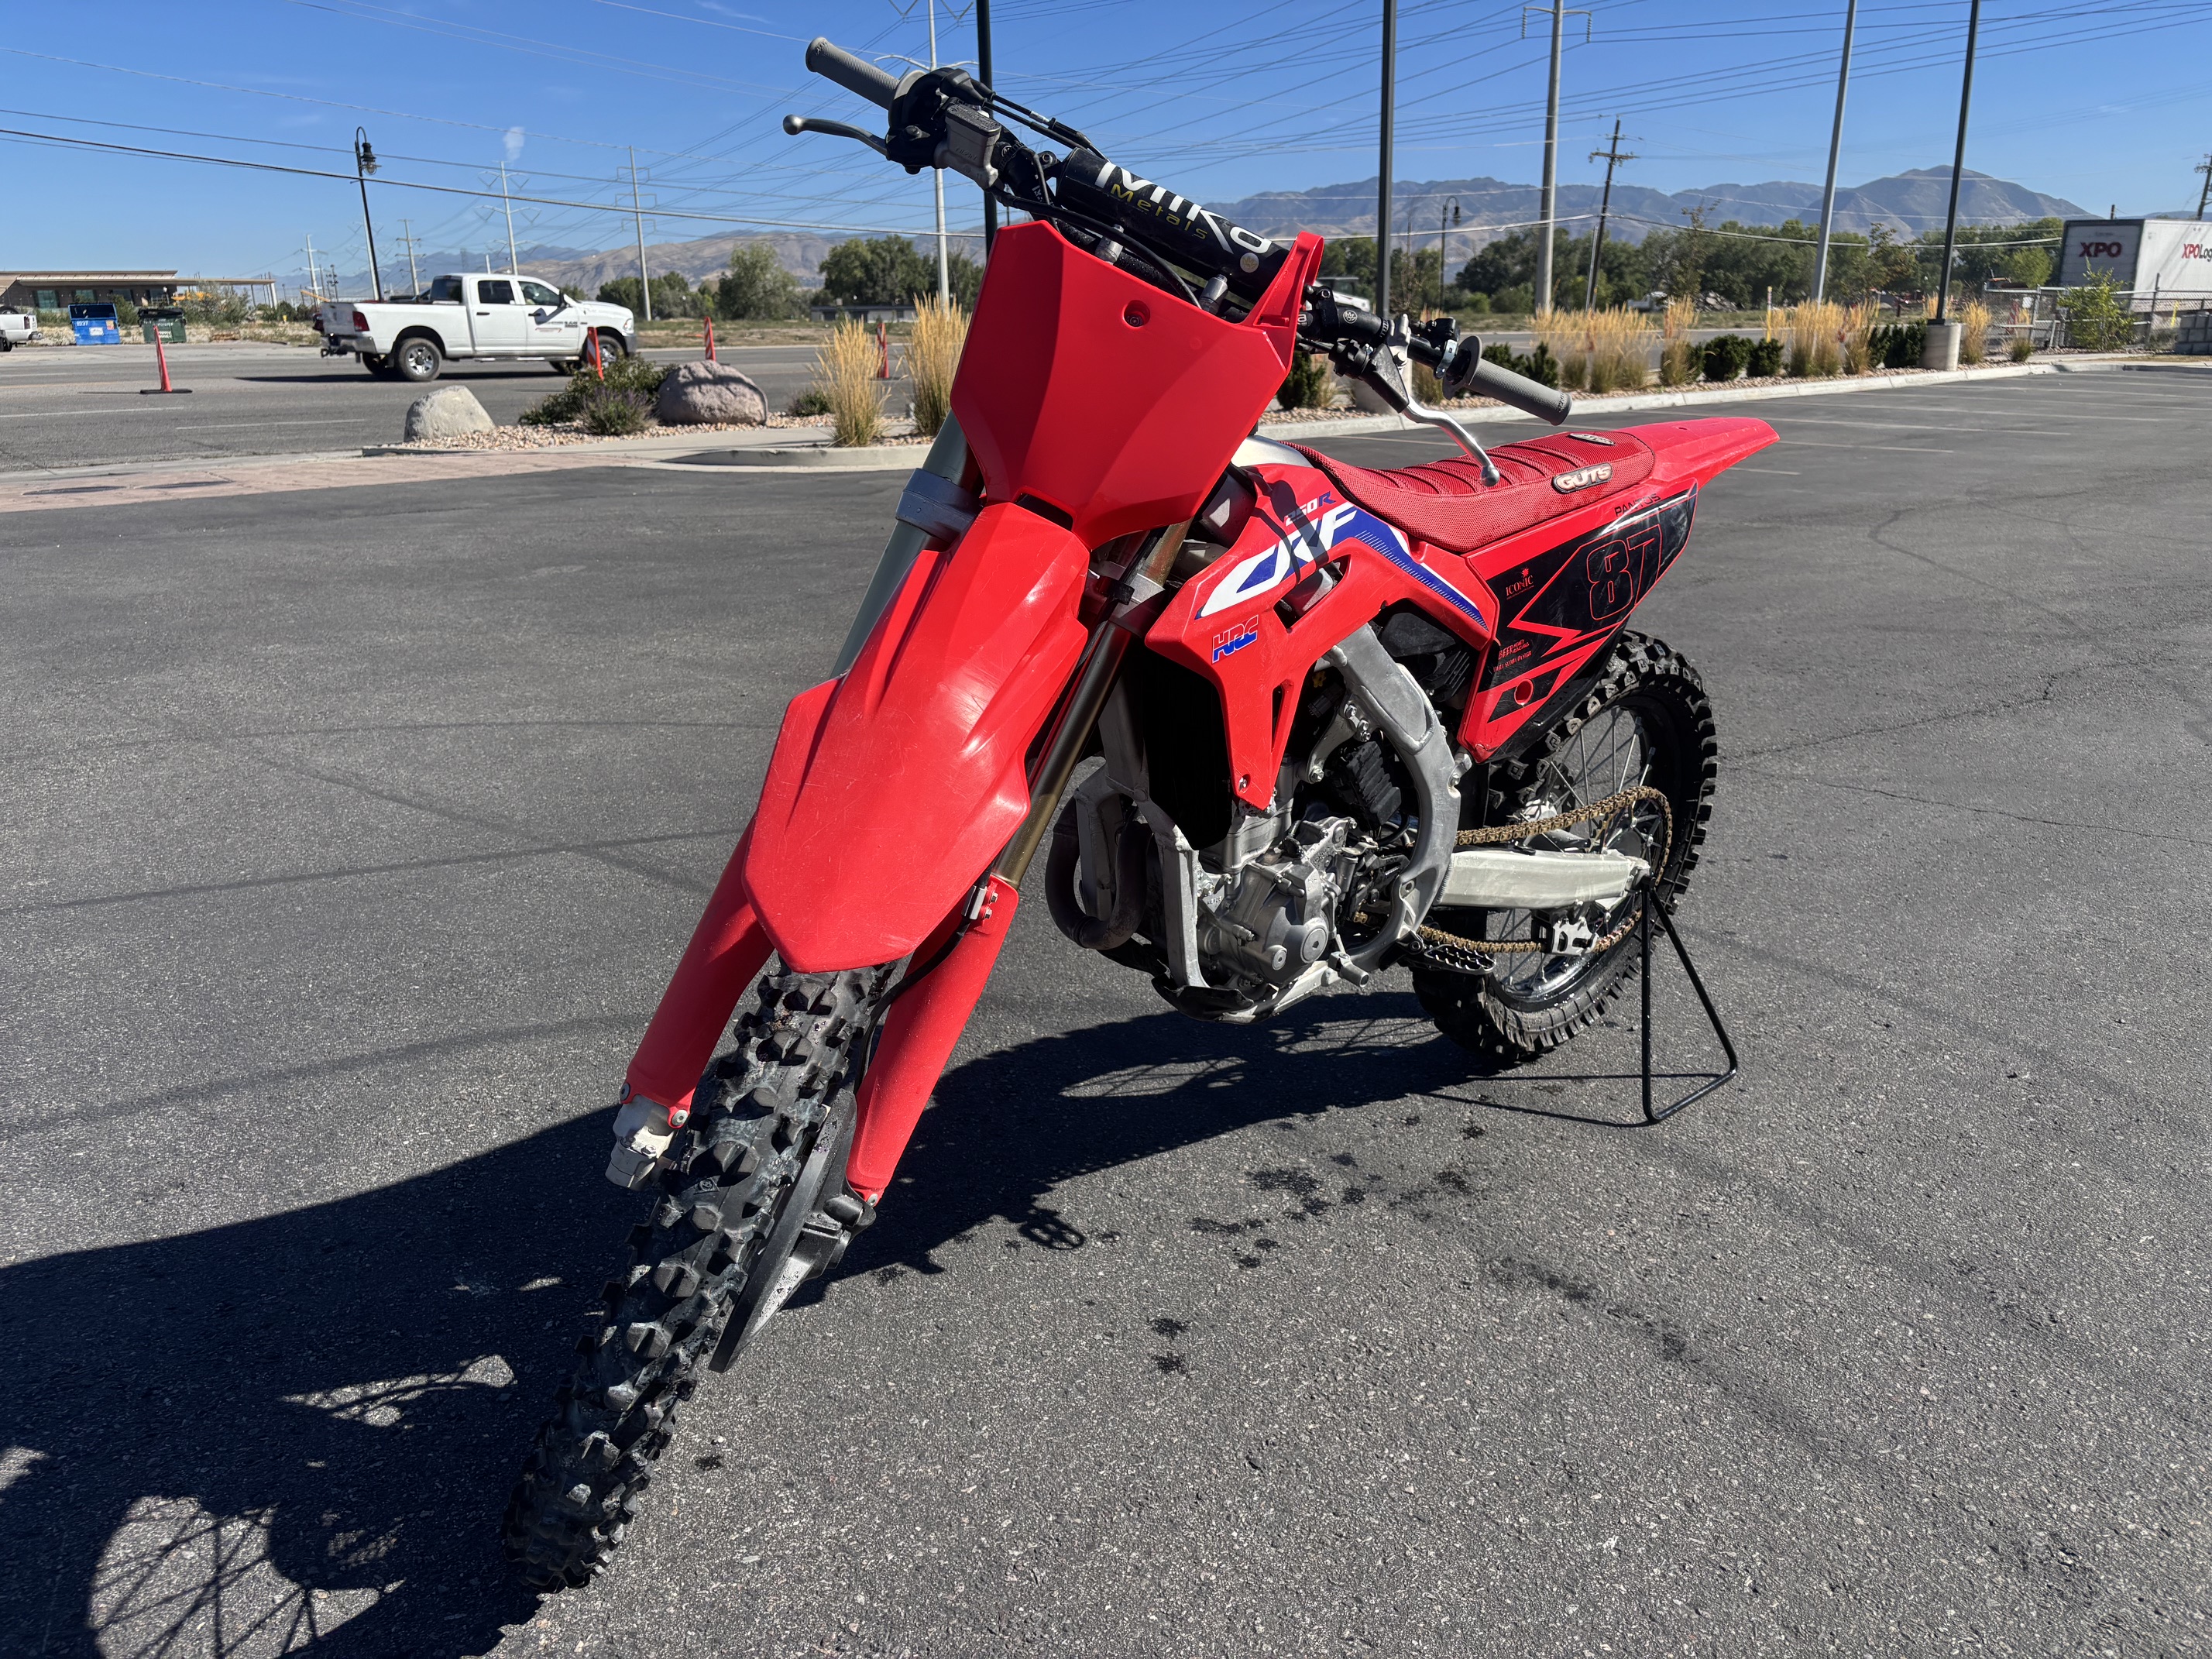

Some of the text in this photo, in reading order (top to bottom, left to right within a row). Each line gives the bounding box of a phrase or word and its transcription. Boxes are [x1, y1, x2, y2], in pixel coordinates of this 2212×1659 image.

[1110, 184, 1207, 240] Metals
[2078, 241, 2123, 258] XPO
[1556, 465, 1611, 490] GUTS
[1614, 493, 1661, 517] PANTOS
[1200, 501, 1358, 618] CRF
[1586, 524, 1663, 621] 87
[1506, 575, 1534, 596] ICONIC
[1211, 613, 1259, 665] HRC
